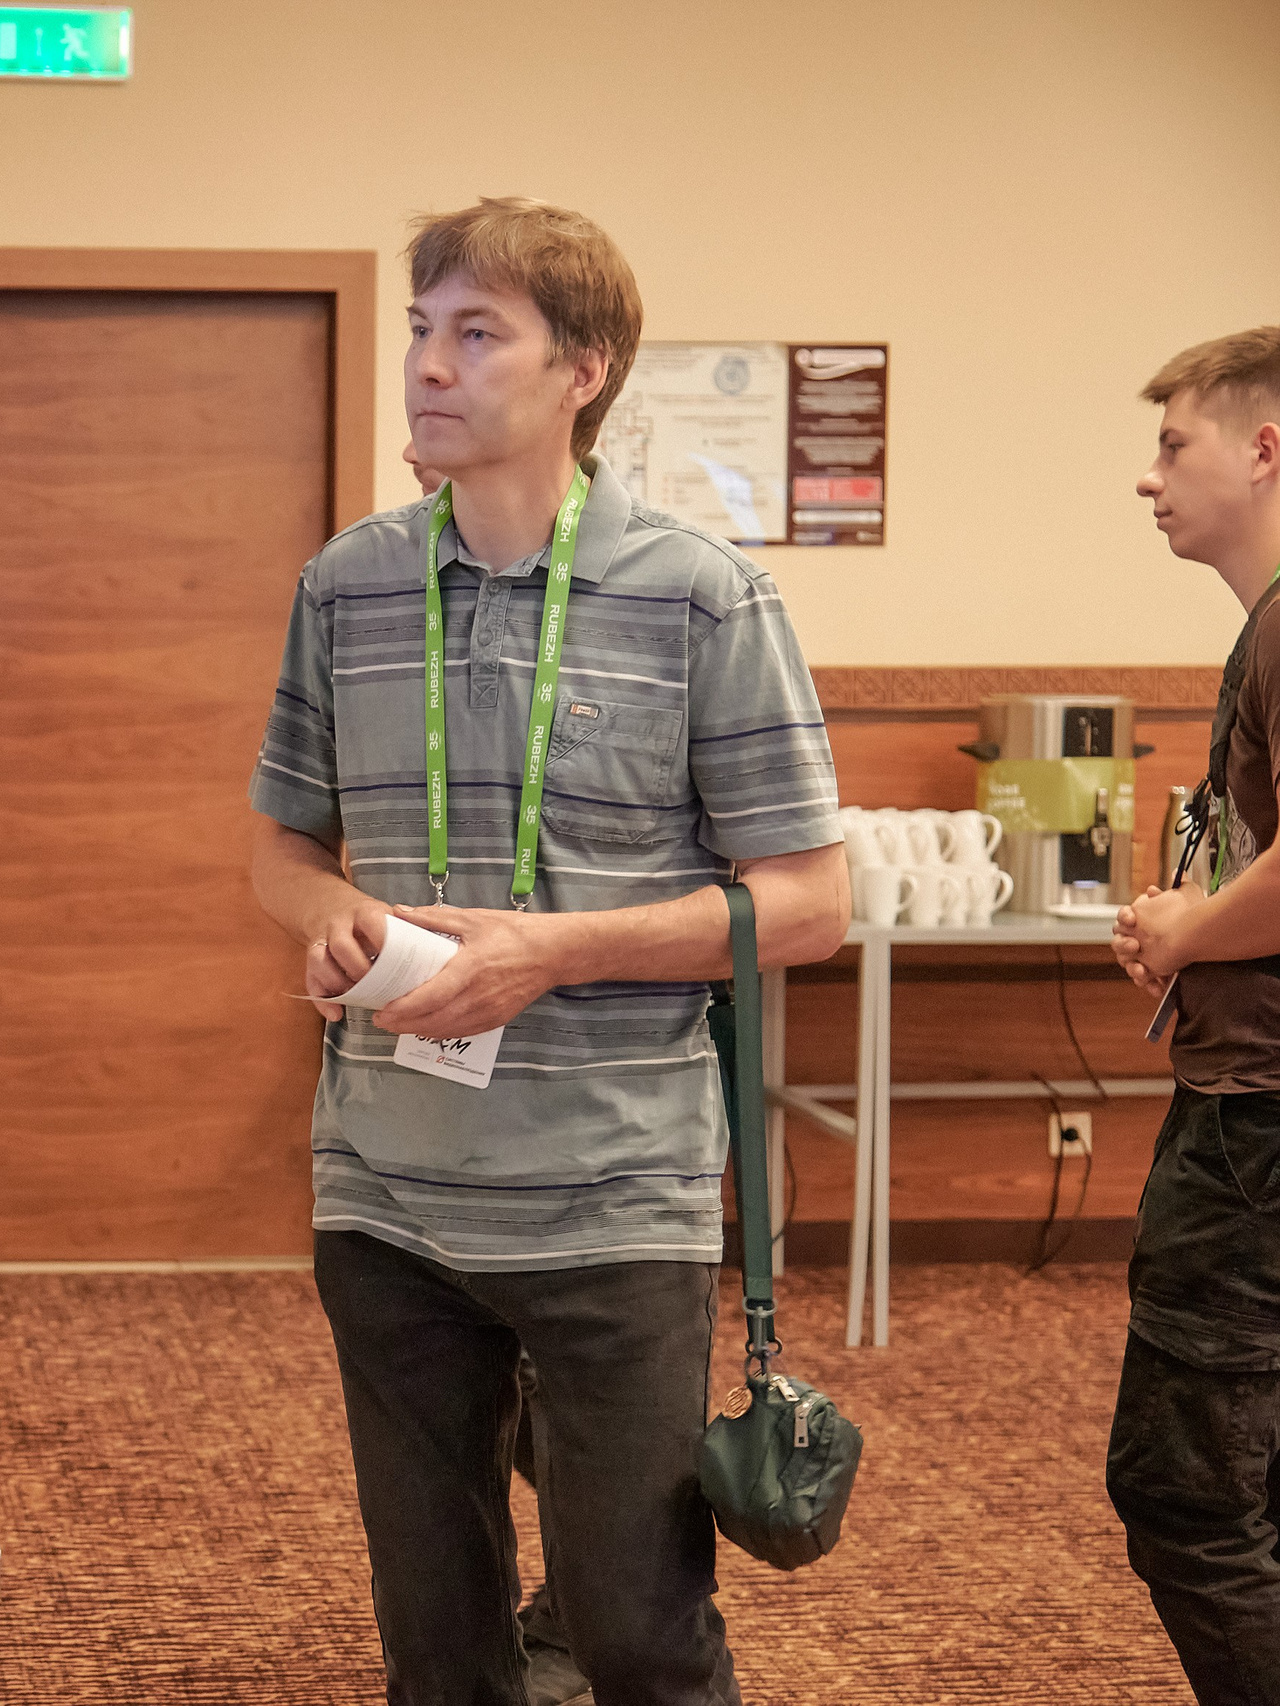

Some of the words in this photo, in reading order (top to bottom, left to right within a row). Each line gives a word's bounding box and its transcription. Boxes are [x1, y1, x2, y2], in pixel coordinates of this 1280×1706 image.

[435, 499, 450, 515] 35
[560, 497, 578, 542] RUBEZH
[428, 531, 437, 589] RUBEZH
[557, 562, 568, 582] 35
[428, 612, 437, 631] 35
[544, 604, 560, 662] RUBEZH
[430, 650, 439, 709] RUBEZH
[541, 682, 552, 702] 35
[429, 731, 438, 751] 35
[528, 725, 545, 784] RUBEZH
[431, 770, 441, 829] RUBEZH
[526, 804, 537, 825] 35
